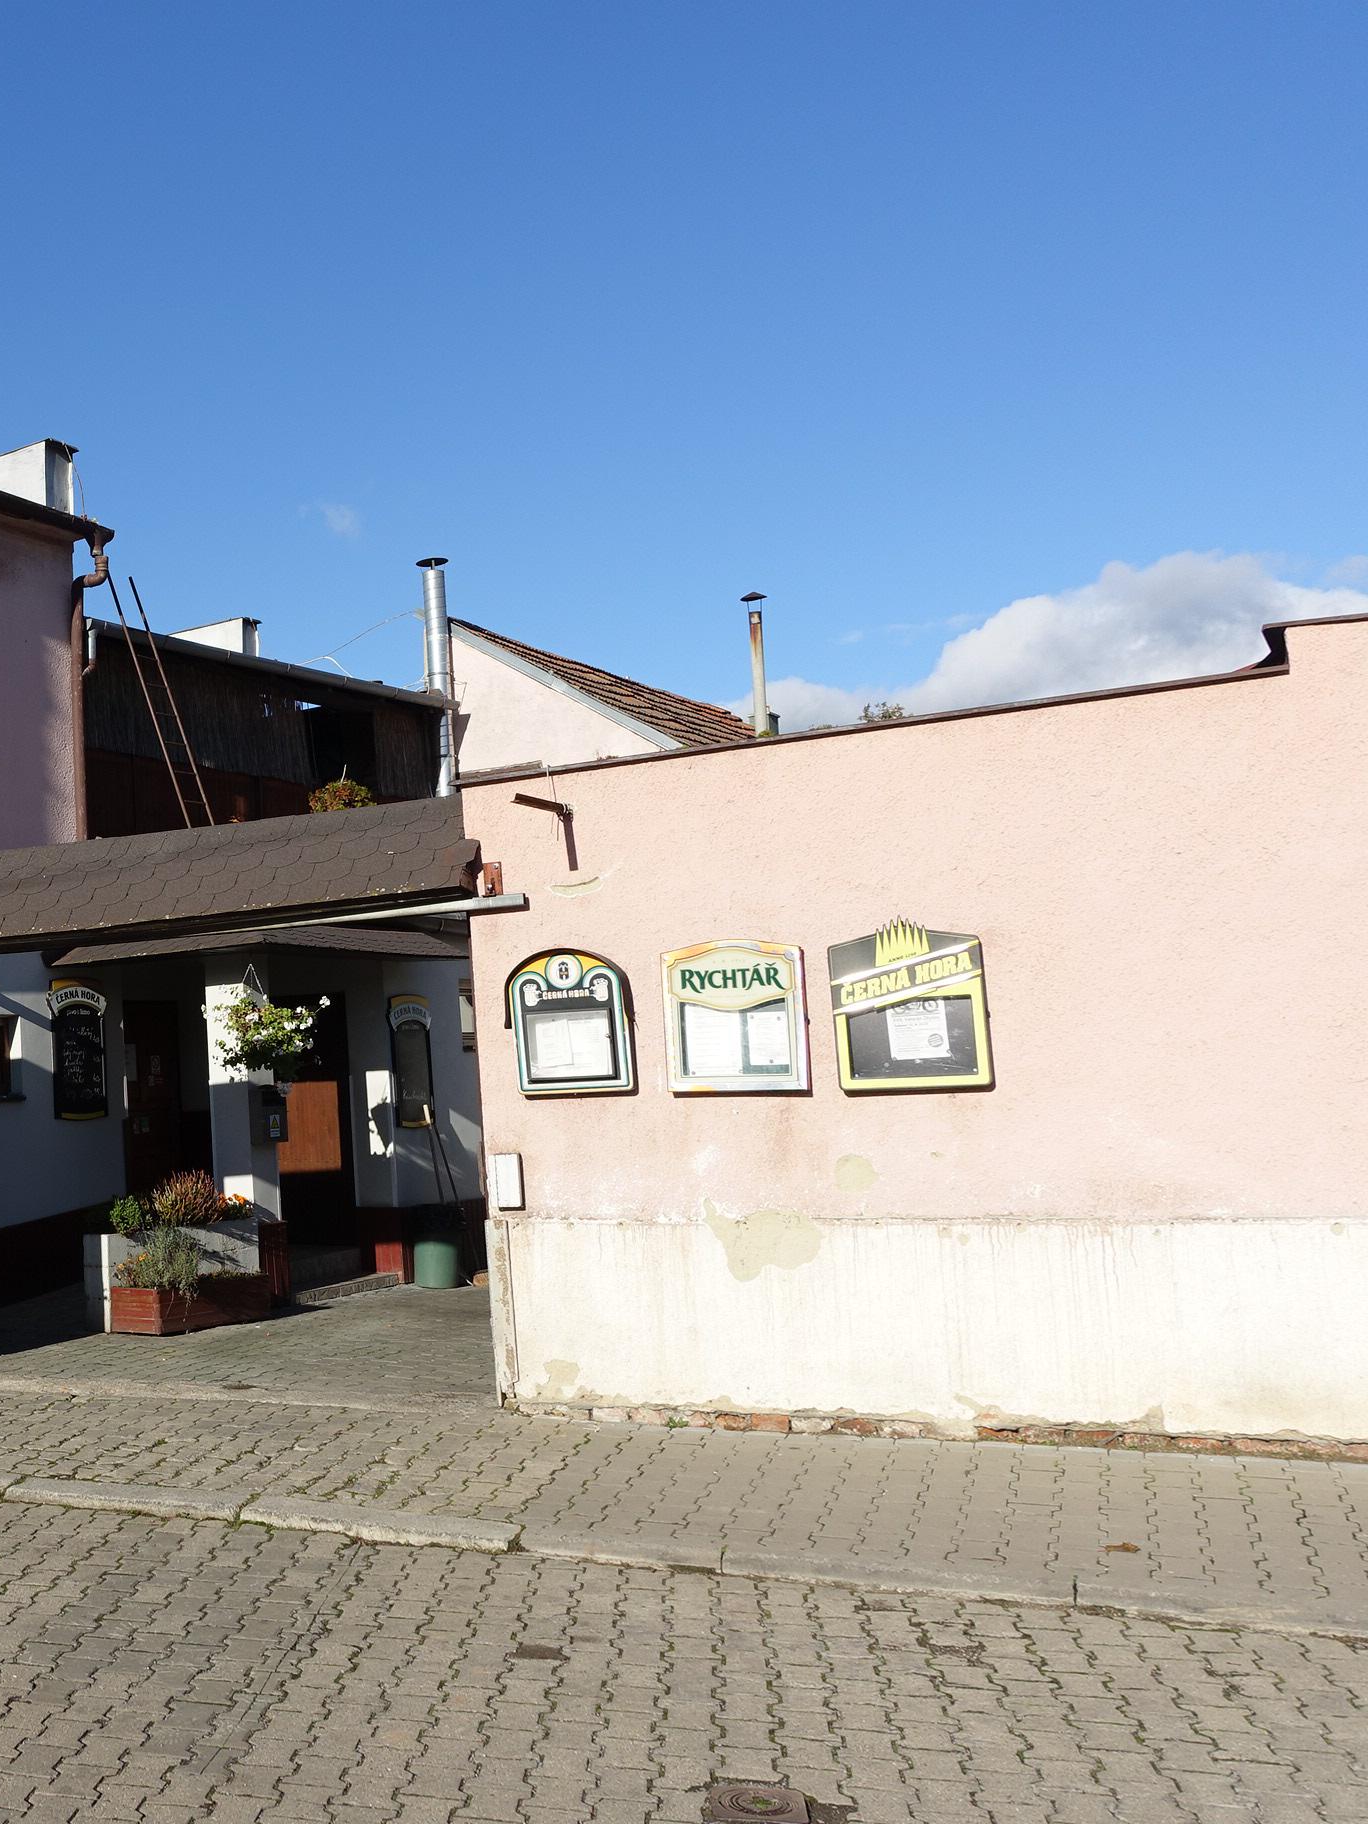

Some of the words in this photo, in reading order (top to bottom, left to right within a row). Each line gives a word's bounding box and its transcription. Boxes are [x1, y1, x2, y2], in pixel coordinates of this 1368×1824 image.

[679, 962, 787, 994] RYCHTÁŘ
[840, 967, 912, 1005] ČERNÁ
[915, 951, 973, 985] HORA
[55, 988, 80, 1005] ČERNÁ
[80, 990, 100, 1006] HORA
[568, 988, 590, 998] HORA
